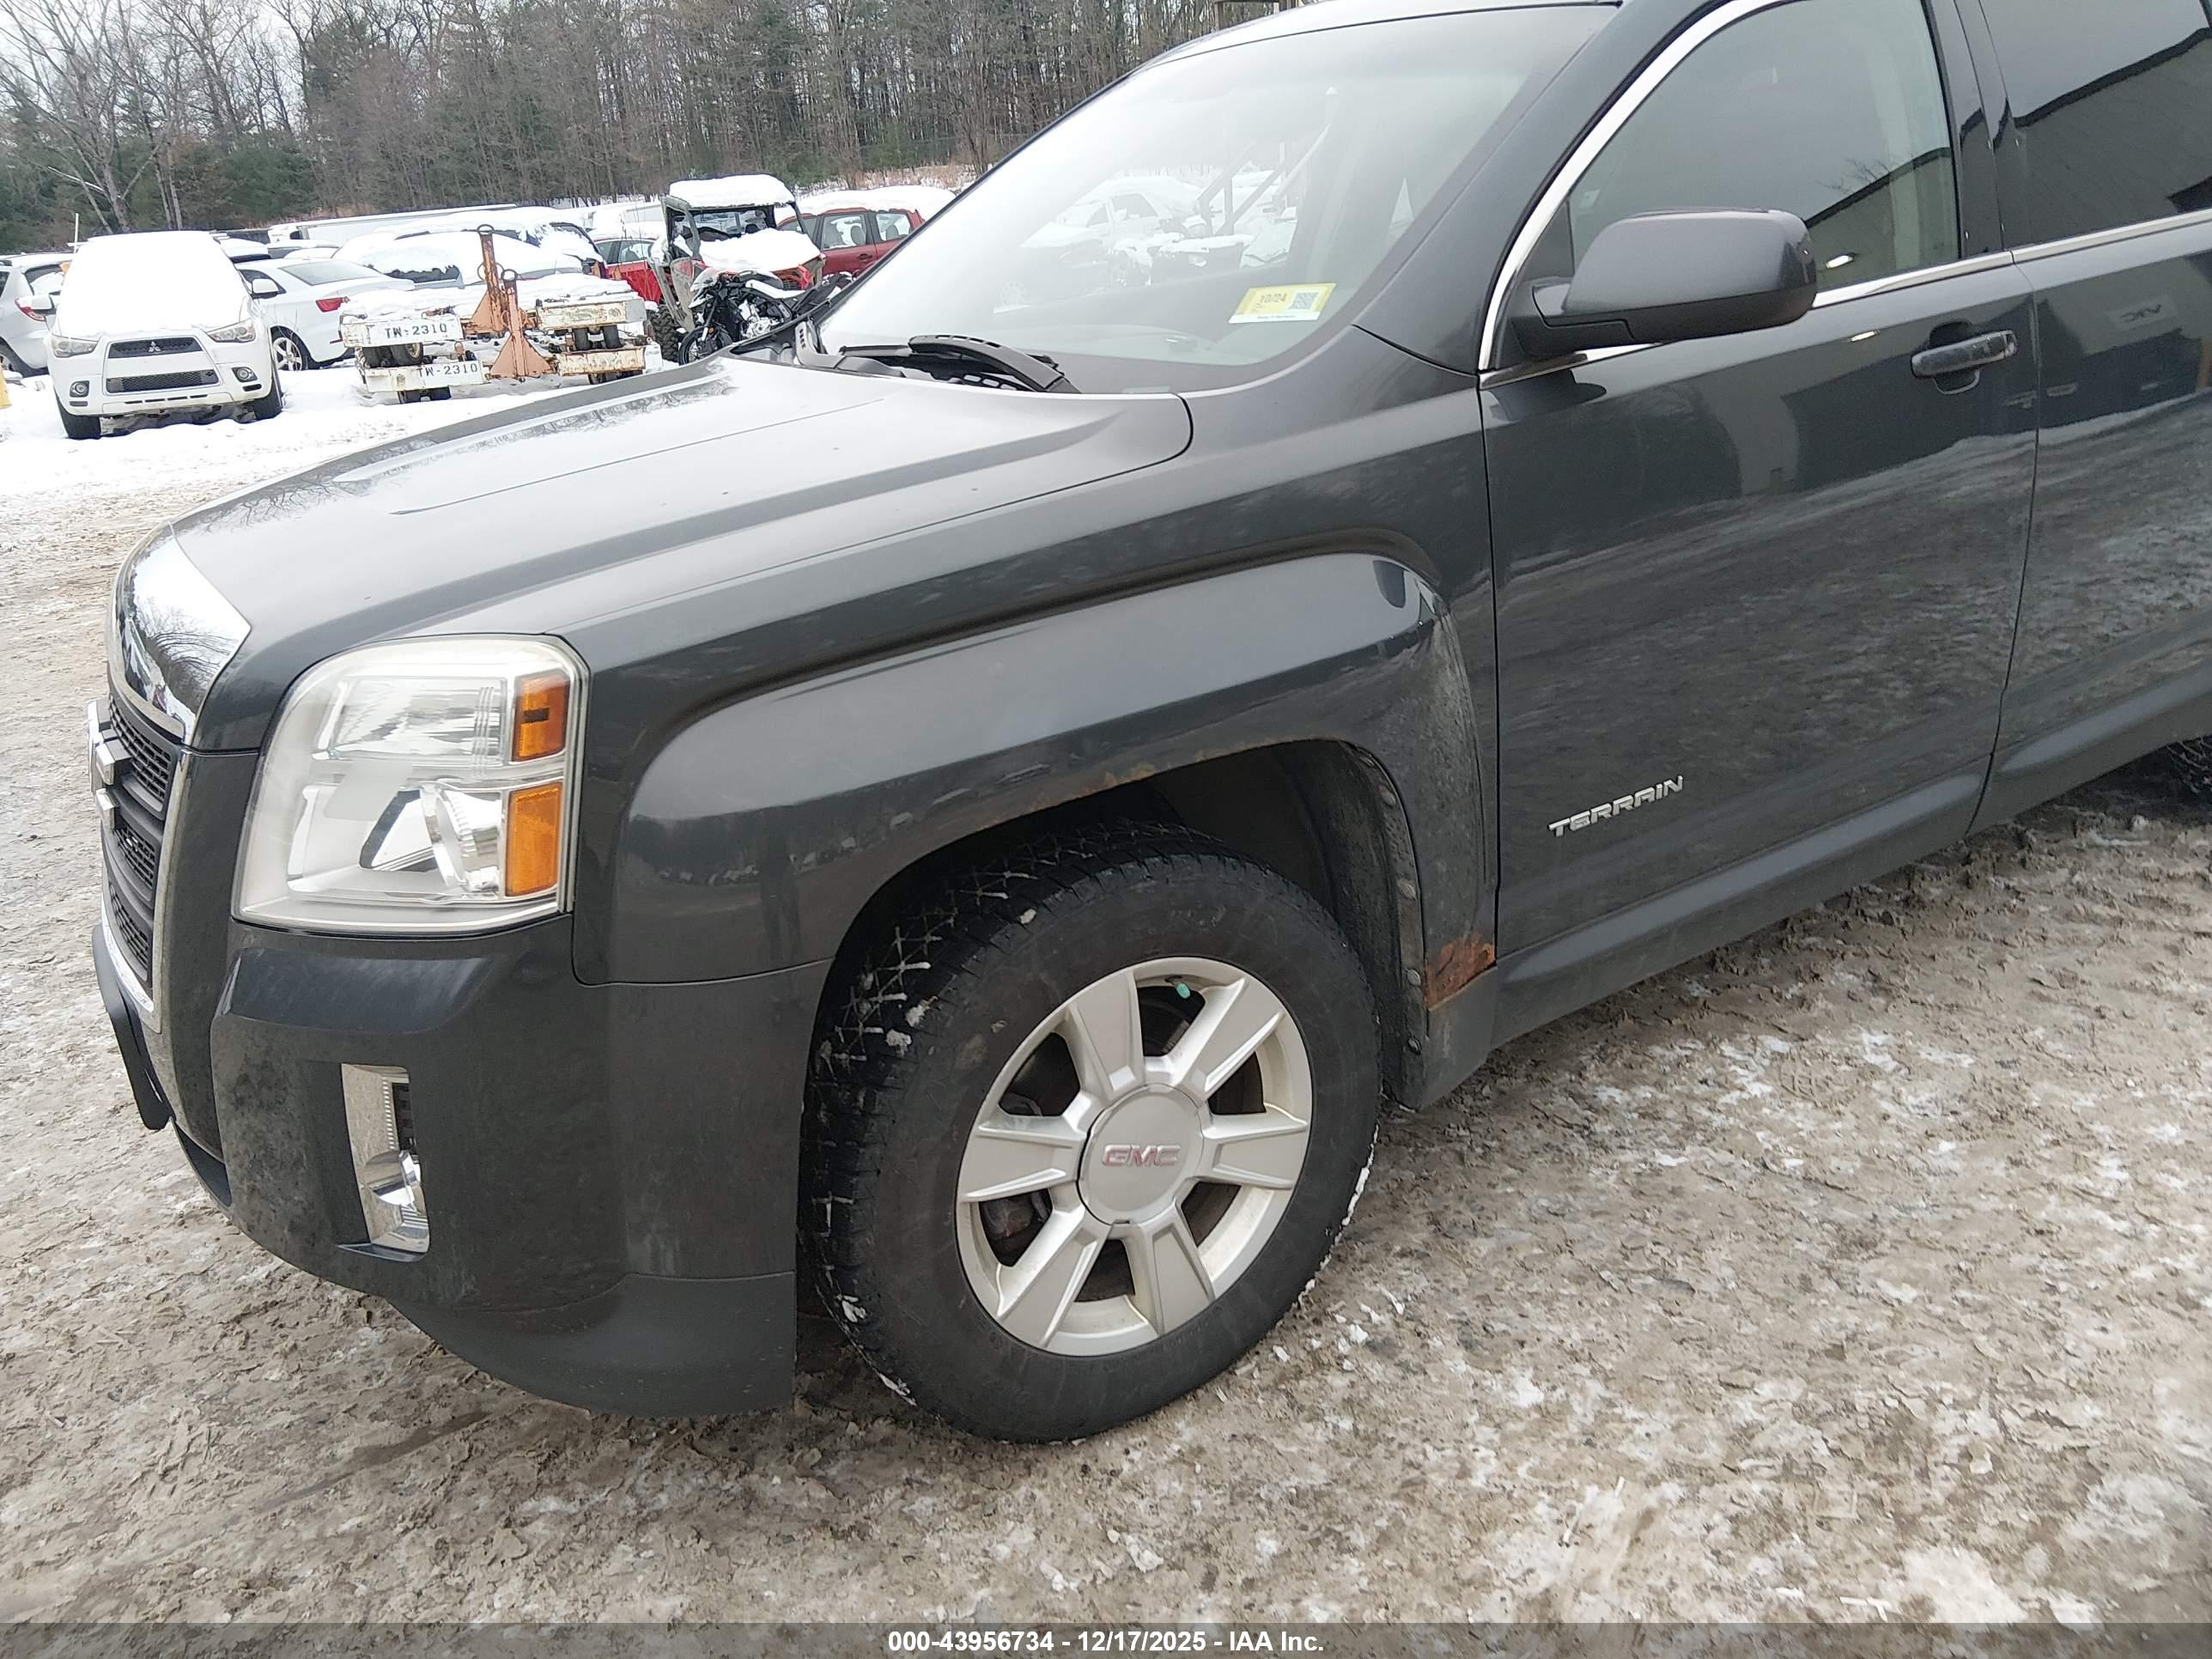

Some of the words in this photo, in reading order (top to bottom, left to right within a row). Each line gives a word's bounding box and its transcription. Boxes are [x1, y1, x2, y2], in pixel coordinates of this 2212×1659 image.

[417, 363, 478, 377] TW-2310
[1547, 775, 1684, 837] TERRAIN
[1102, 1144, 1182, 1167] GMC
